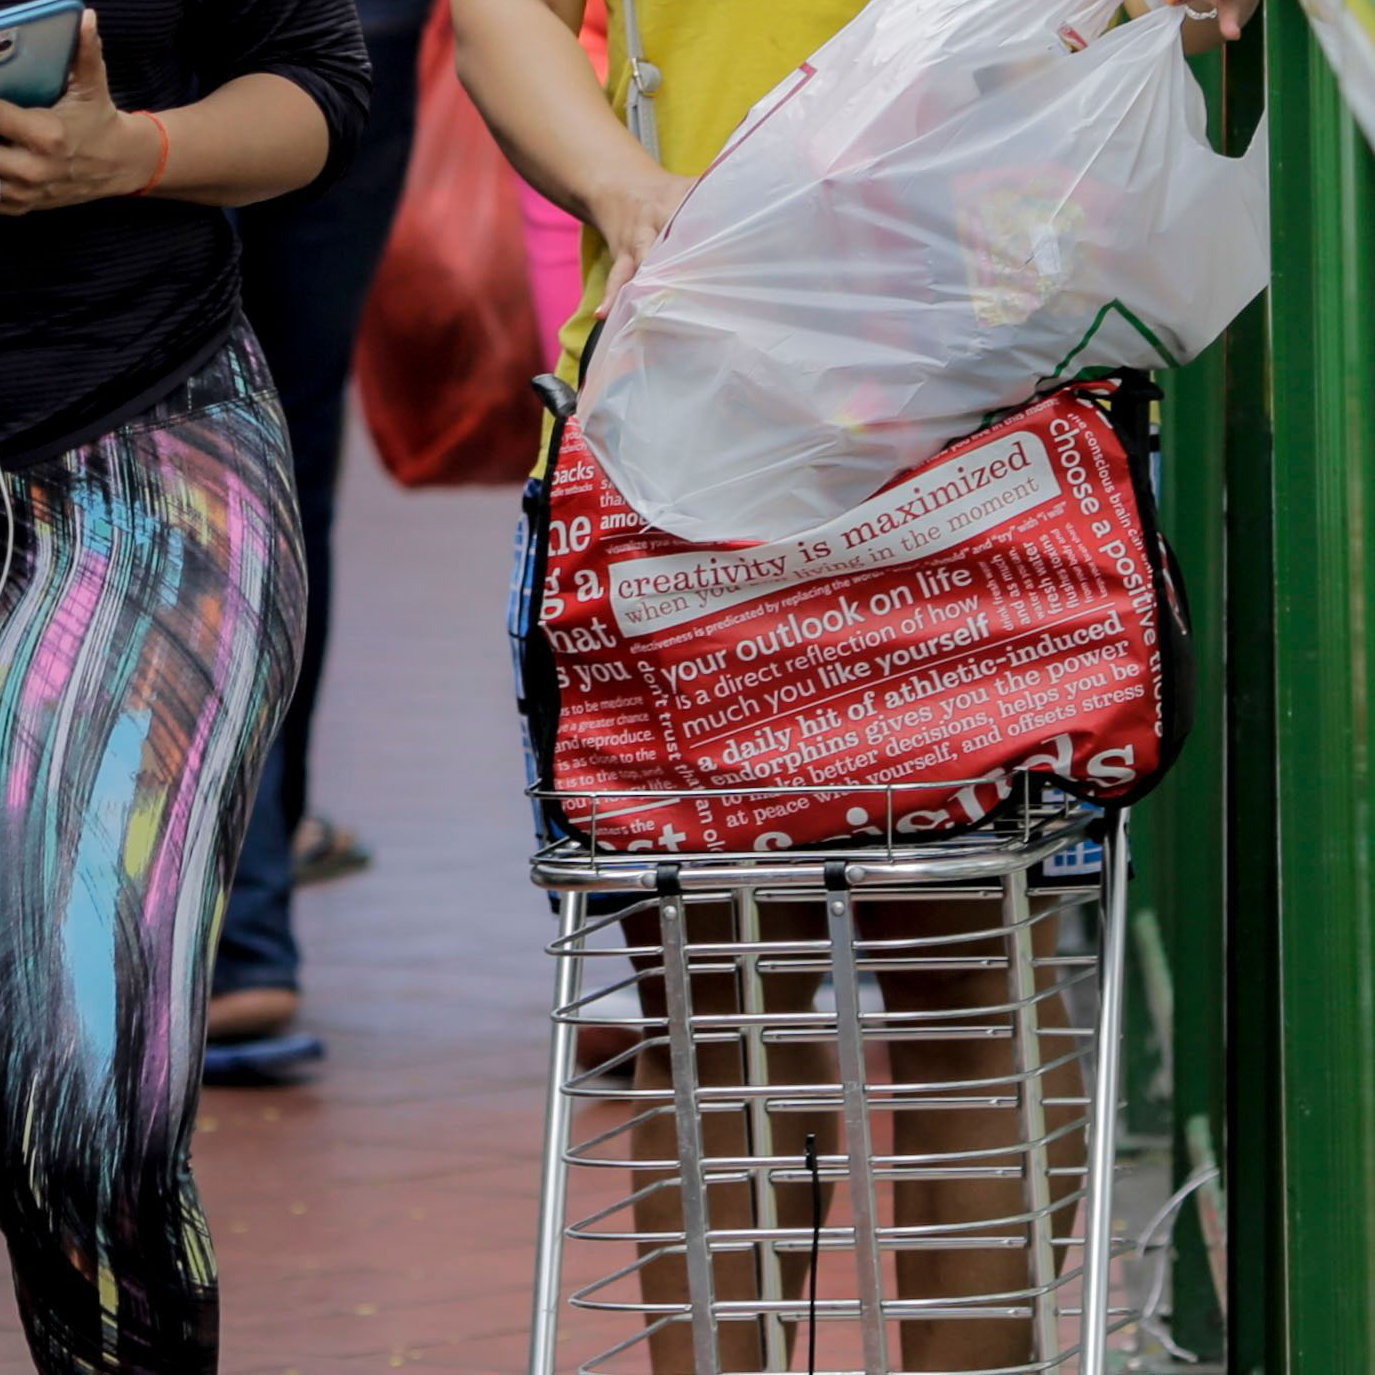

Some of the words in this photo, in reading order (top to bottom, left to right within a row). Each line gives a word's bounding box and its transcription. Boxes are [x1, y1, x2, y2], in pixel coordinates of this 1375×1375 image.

[1049, 418, 1100, 515] choose
[1084, 430, 1115, 494] conscious
[1109, 493, 1132, 529] brain
[618, 554, 787, 600] creativity
[798, 541, 831, 564] is
[840, 440, 1032, 549] maximized
[1091, 520, 1111, 539] a
[624, 596, 690, 626] when
[794, 558, 867, 581] living
[868, 546, 896, 563] in
[901, 525, 942, 553] the
[947, 476, 1040, 532] moment
[990, 554, 1014, 583] much
[1023, 541, 1048, 581] water
[1039, 533, 1063, 569] toxins
[574, 569, 605, 603] a
[629, 630, 694, 655] effectiveness
[694, 626, 706, 638] is
[706, 605, 766, 637] predicated
[765, 598, 781, 614] by
[781, 584, 833, 609] replacing
[832, 577, 851, 591] the
[972, 539, 994, 555] and
[1006, 582, 1021, 599] as
[1028, 591, 1046, 621] water
[1038, 577, 1064, 616] fresh
[1057, 568, 1081, 610] flushes
[1080, 583, 1095, 604] from
[1099, 539, 1157, 646] positive
[660, 648, 729, 695] your
[736, 596, 866, 662] outlook
[869, 585, 915, 616] on
[916, 567, 973, 600] life
[1010, 599, 1032, 626] and
[695, 689, 712, 707] a
[714, 664, 783, 699] direct
[785, 624, 897, 673] reflection
[901, 607, 925, 635] of
[926, 594, 979, 624] how
[572, 660, 633, 693] you
[682, 695, 761, 739] much
[763, 679, 817, 714] you
[818, 660, 872, 690] like
[875, 612, 990, 676] yourself
[697, 755, 718, 773] a
[722, 725, 792, 765] daily
[795, 708, 843, 739] hit
[847, 690, 878, 721] of
[884, 610, 1125, 710] athletic-induced
[572, 702, 584, 715] to
[584, 700, 599, 714] be
[711, 730, 860, 786] endorphins
[865, 705, 933, 746] gives
[939, 687, 990, 720] you
[994, 669, 1041, 696] the
[1046, 640, 1129, 685] power
[807, 748, 879, 784] better
[885, 711, 994, 757] decisions,
[997, 687, 1060, 719] helps
[1064, 672, 1107, 701] you
[1109, 661, 1140, 682] be
[558, 758, 570, 771] is
[573, 757, 587, 769] as
[619, 752, 633, 764] to
[635, 748, 657, 762] the
[637, 661, 670, 708] don't
[659, 711, 682, 762] trust
[696, 799, 713, 824] an
[726, 810, 749, 828] at
[752, 796, 810, 826] peace
[866, 741, 960, 786] yourself,
[962, 724, 1003, 754] and
[1007, 703, 1077, 737] offsets
[1082, 683, 1146, 713] stress
[566, 777, 578, 788] is
[579, 774, 595, 786] to
[596, 769, 618, 783] the
[630, 818, 656, 834] the
